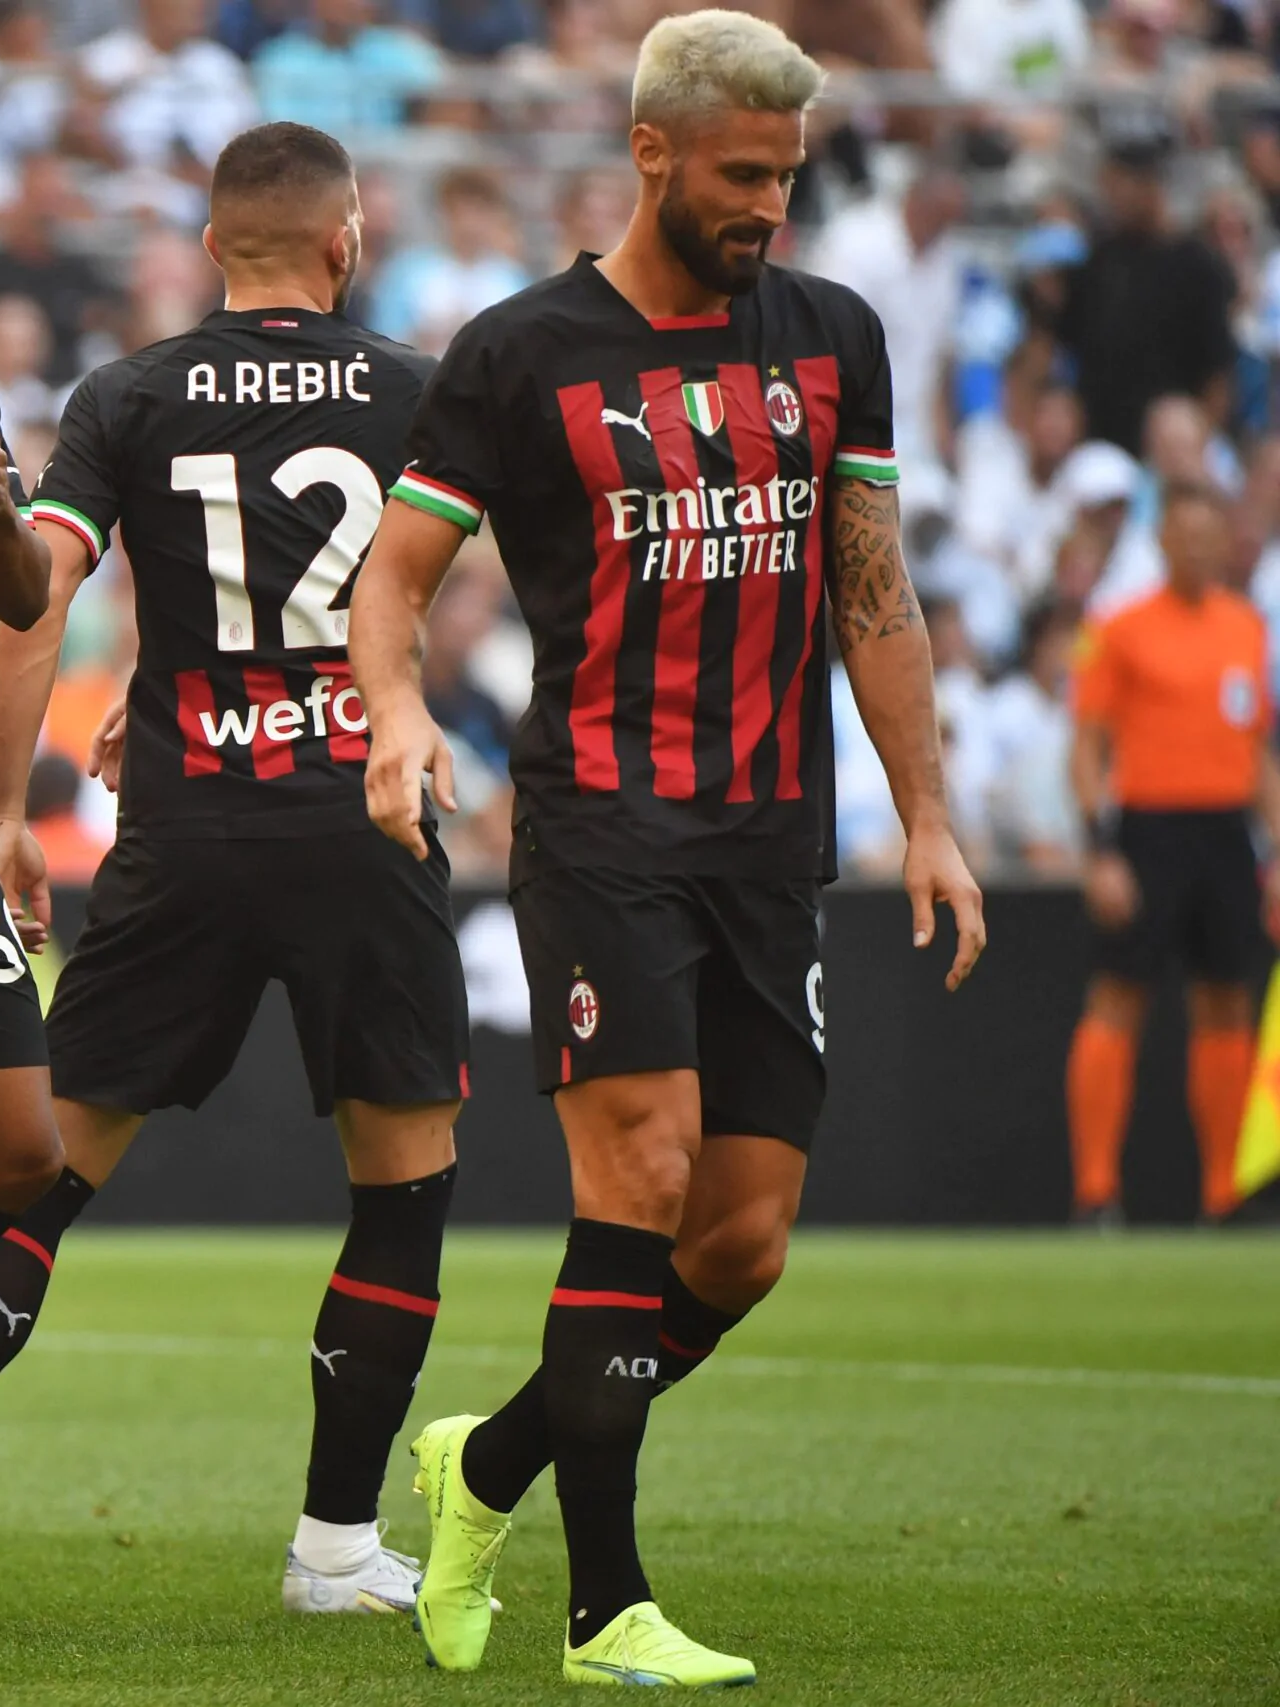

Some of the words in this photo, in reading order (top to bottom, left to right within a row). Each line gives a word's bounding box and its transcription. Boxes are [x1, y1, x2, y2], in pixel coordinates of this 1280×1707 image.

[604, 474, 819, 540] Emirates
[171, 447, 384, 651] 12
[642, 538, 695, 581] FLY
[701, 530, 796, 579] BETTER
